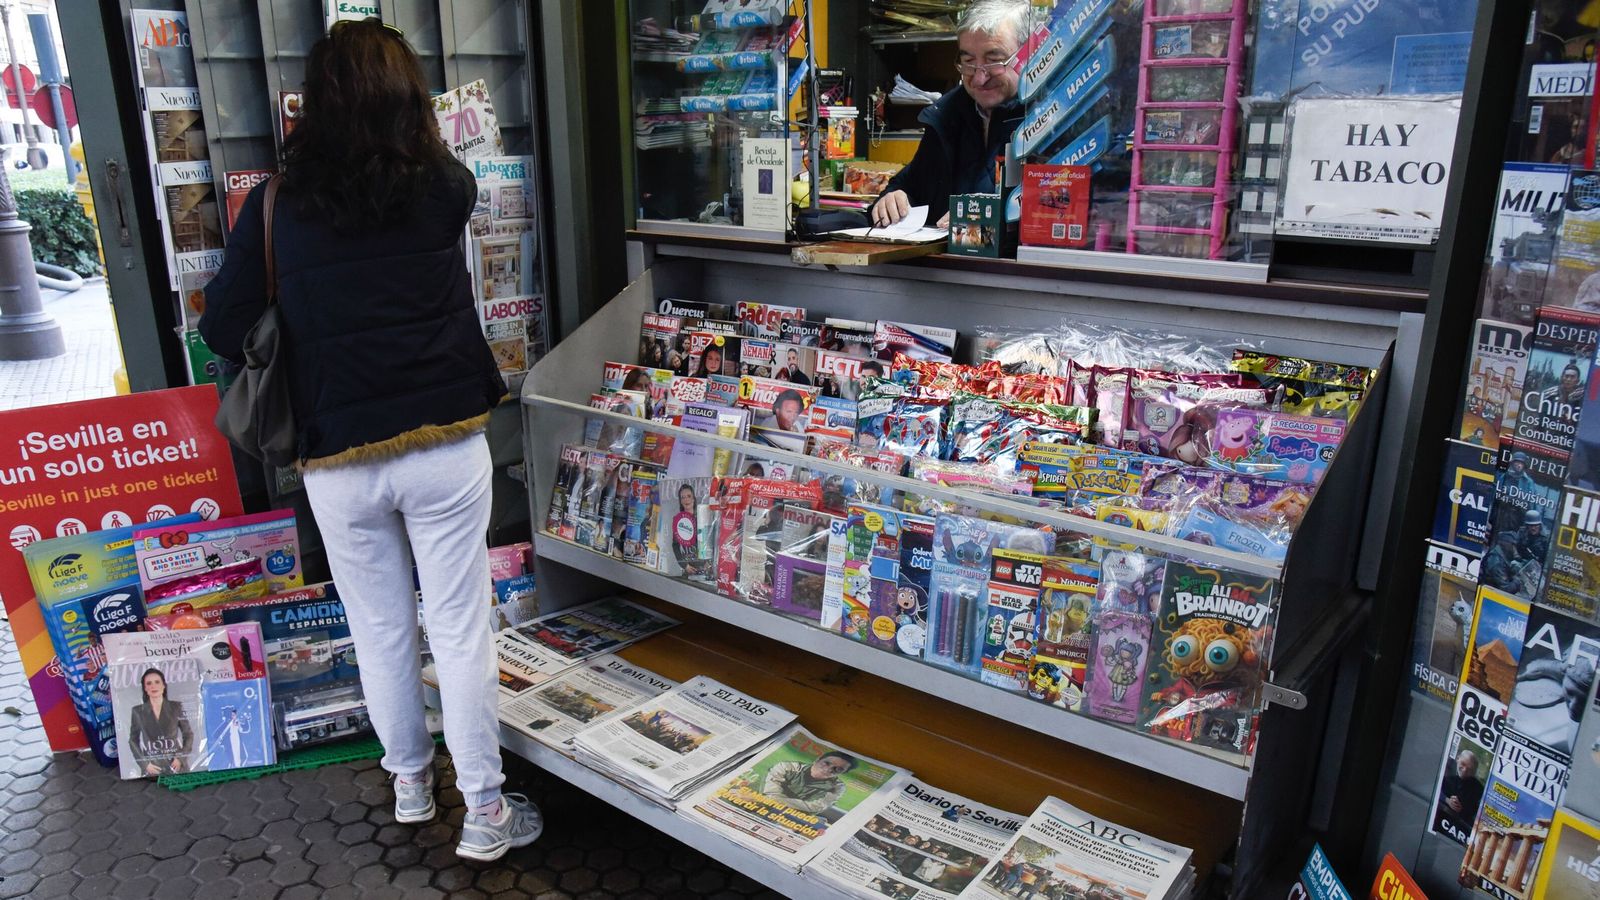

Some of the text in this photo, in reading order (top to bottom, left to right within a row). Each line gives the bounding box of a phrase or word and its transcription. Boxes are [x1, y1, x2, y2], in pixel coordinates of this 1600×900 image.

[738, 14, 758, 24] Orbit
[739, 53, 758, 65] Orbit
[1301, 34, 1333, 67] SU
[692, 60, 710, 68] Orbit
[1026, 38, 1063, 84] Trident
[1066, 59, 1102, 101] HALLS
[695, 99, 712, 110] Orbit
[743, 98, 761, 107] Orbit
[445, 107, 481, 143] 70
[1022, 100, 1060, 143] Trident
[455, 135, 486, 153] PLANTAS
[1345, 123, 1418, 147] HAY
[754, 146, 778, 160] Revista
[755, 156, 785, 167] Occidente
[475, 160, 525, 178] Labores
[1311, 159, 1446, 186] TABACO
[484, 297, 543, 320] LABORES
[659, 299, 704, 319] Quercus
[743, 342, 775, 361] SEMANA
[688, 407, 714, 417] REGALO
[1521, 411, 1540, 426] Los
[1279, 420, 1317, 432] REGALOS!
[18, 420, 168, 461] ¡Sevilla en
[1271, 438, 1316, 458] Peppa Pig
[0, 438, 199, 485] un solo ticket!
[61, 488, 79, 503] in
[83, 483, 118, 504] just
[123, 478, 158, 494] one
[162, 468, 219, 489] ticket!
[1449, 488, 1489, 513] GAL
[1228, 531, 1267, 554] FROZEN
[151, 551, 198, 566] HELLO KITTY
[153, 556, 200, 571] AND FRIENDS
[272, 556, 284, 565] 10
[55, 566, 76, 578] Liga
[996, 566, 1012, 574] LEGO
[53, 573, 88, 588] moeve
[1001, 596, 1022, 605] STAR
[1001, 600, 1023, 610] WARS
[1176, 592, 1274, 628] BRAINROT
[101, 605, 133, 622] Liga F
[1217, 613, 1233, 621] CARD
[1232, 617, 1249, 627] GAME
[99, 614, 138, 633] moeve
[144, 644, 192, 658] benefit
[1056, 649, 1088, 660] NINJAGO
[628, 670, 673, 691] MUNDO
[1414, 663, 1446, 692] FÍSICA
[712, 689, 734, 703] EL
[732, 698, 768, 717] PAÍS
[1499, 756, 1510, 774] Y
[1507, 763, 1557, 802] VIDA
[904, 783, 951, 810] Diario
[1030, 823, 1057, 839] hallar
[1056, 834, 1079, 850] fallos
[1079, 845, 1116, 864] internos
[1062, 825, 1092, 843] admite
[1091, 839, 1108, 849] que
[1078, 820, 1142, 848] ABC
[1040, 822, 1056, 832] con
[1055, 829, 1093, 852] personal
[1102, 848, 1134, 864] medios
[1133, 859, 1156, 873] para
